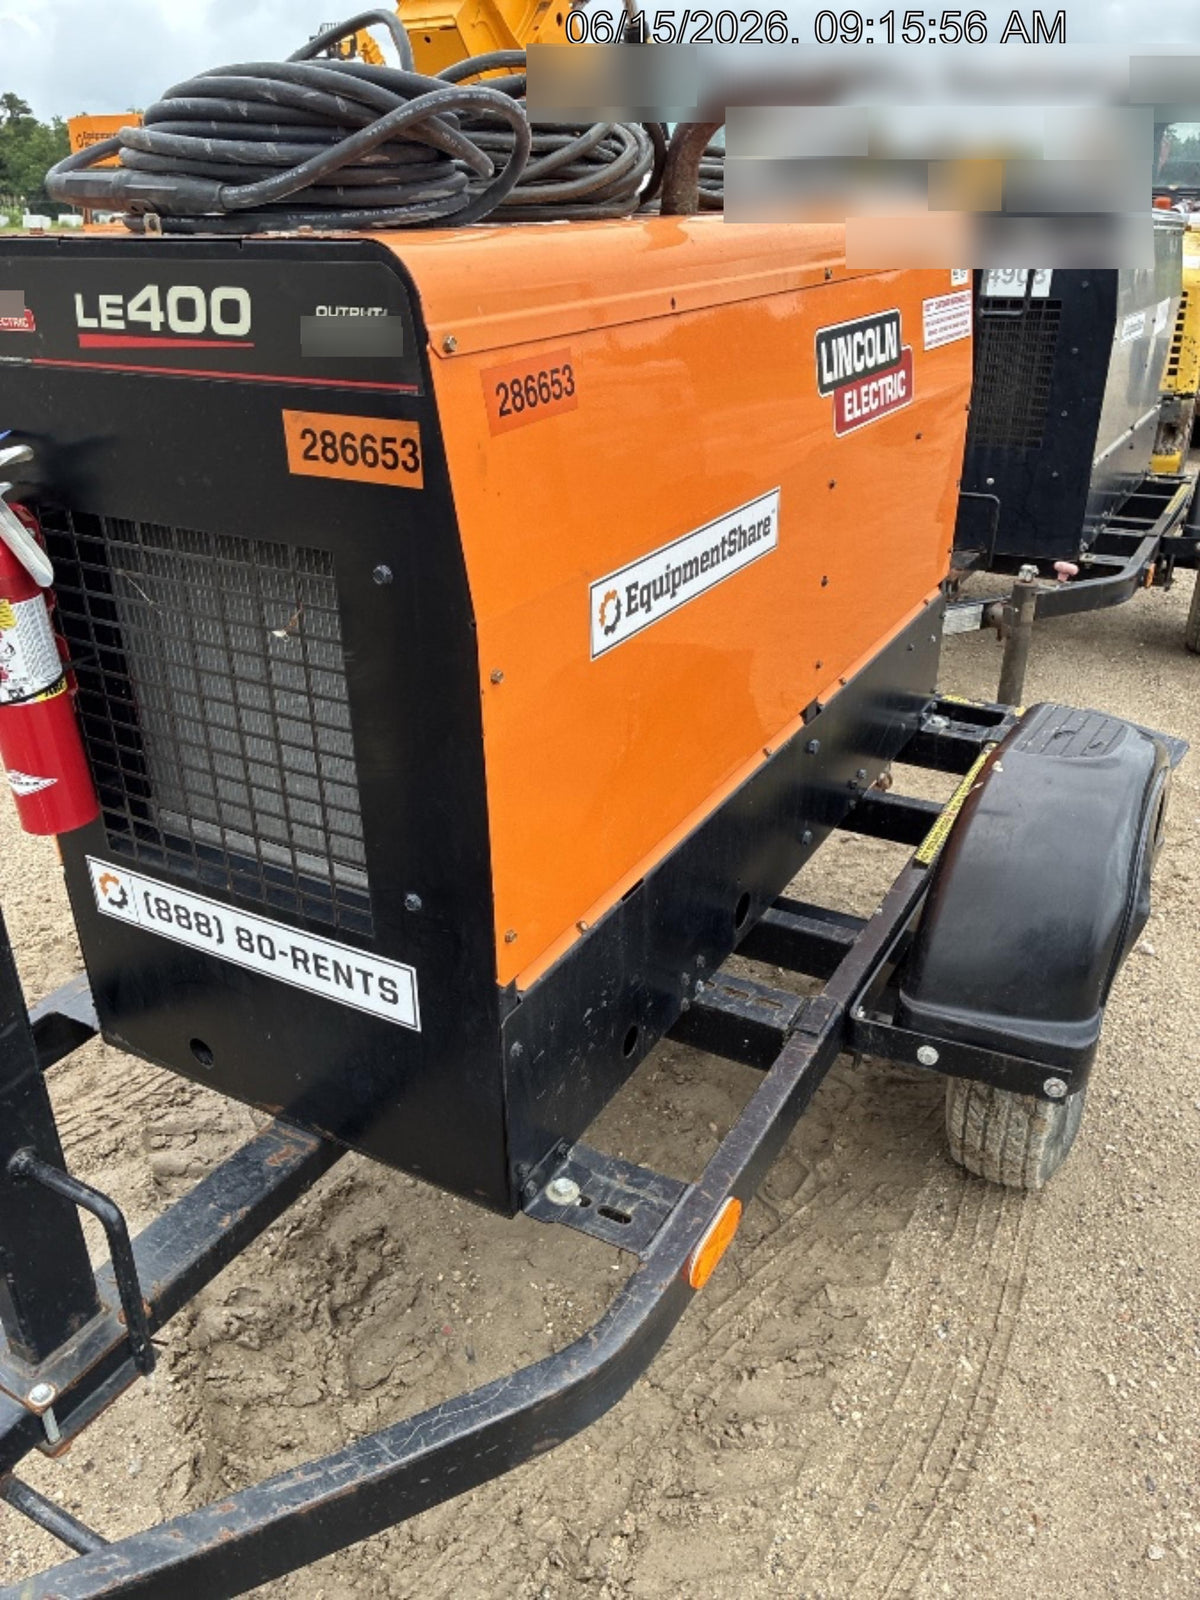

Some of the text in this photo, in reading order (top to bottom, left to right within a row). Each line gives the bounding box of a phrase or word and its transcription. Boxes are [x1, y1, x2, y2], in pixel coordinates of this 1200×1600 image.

[74, 284, 251, 337] LE400
[821, 320, 898, 385] LINCOLN
[495, 363, 576, 417] 286653
[843, 370, 907, 422] ELECTRIC
[300, 428, 420, 473] 286653
[625, 516, 771, 617] EquipmentShare
[143, 891, 399, 1005] (888) 80-RENTS
